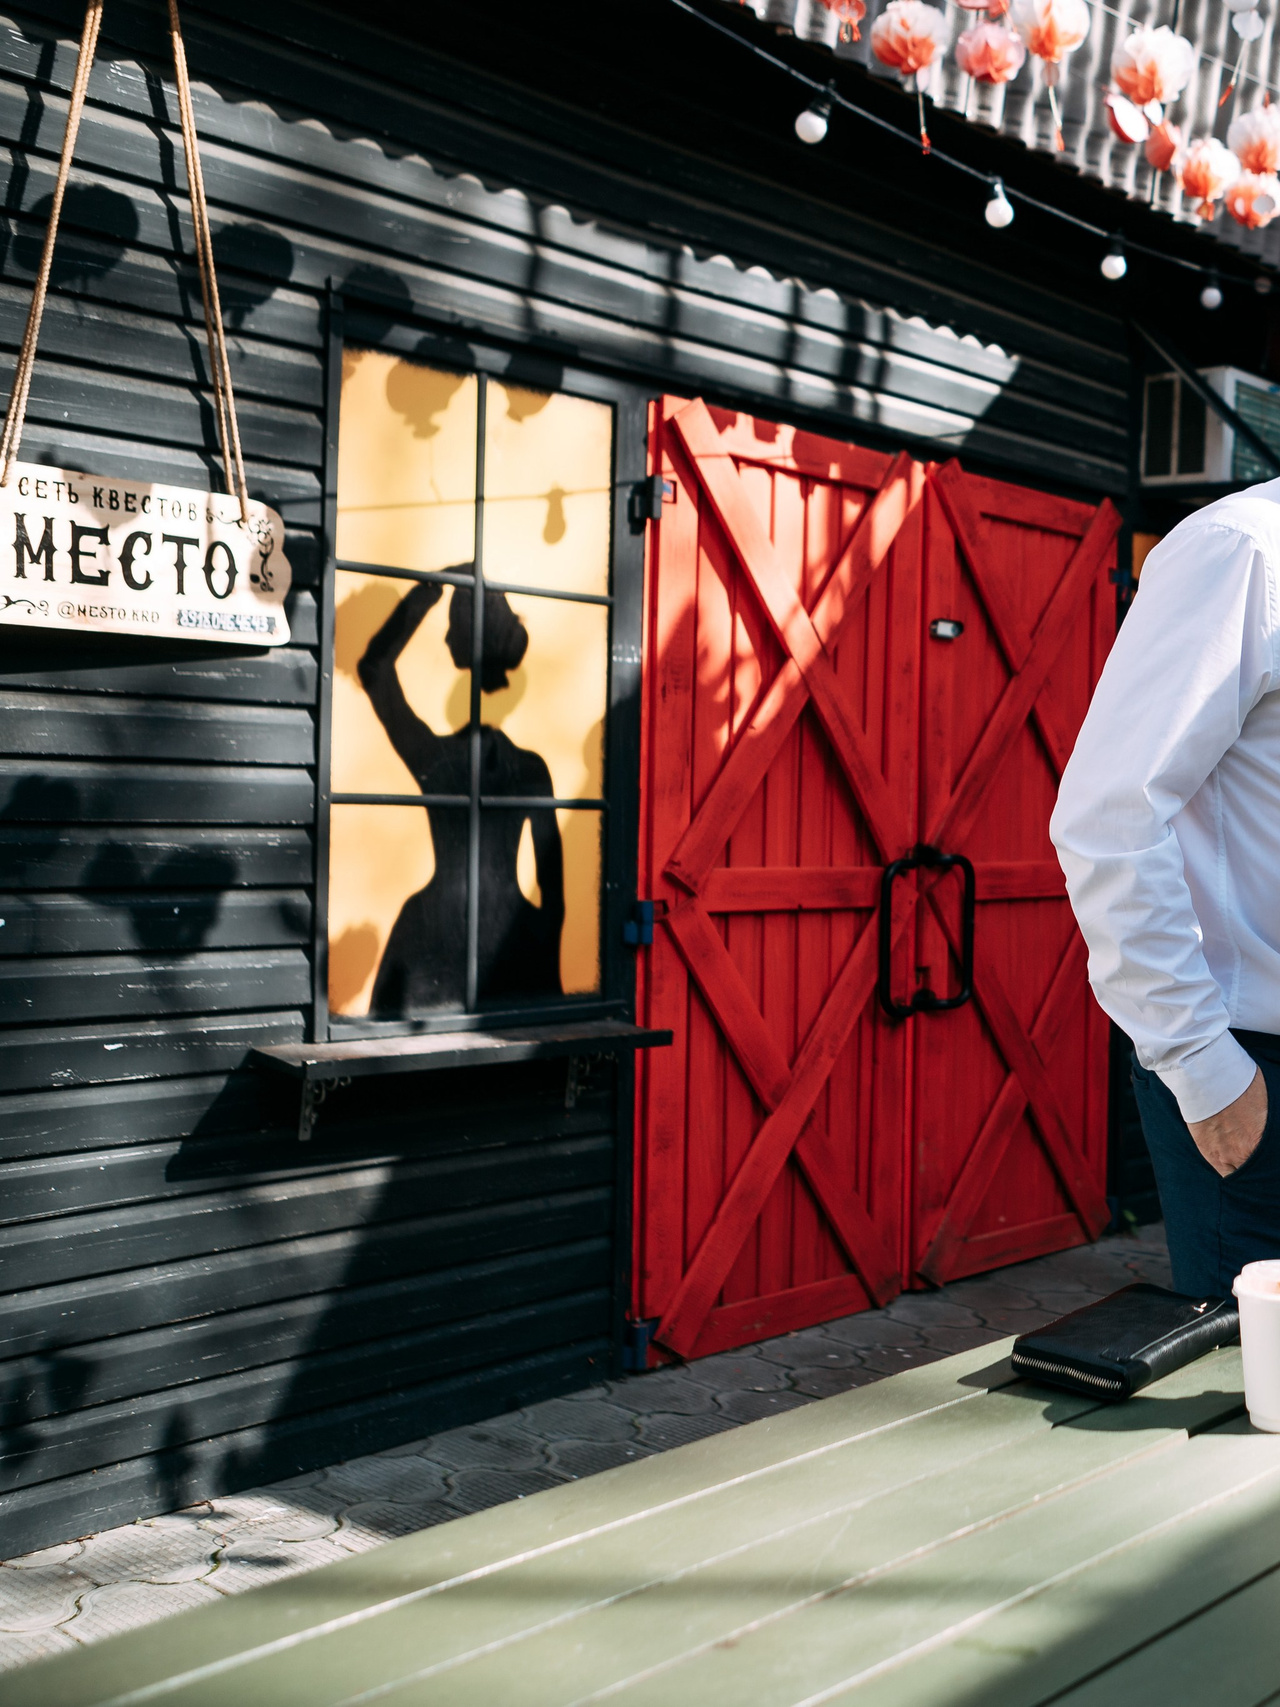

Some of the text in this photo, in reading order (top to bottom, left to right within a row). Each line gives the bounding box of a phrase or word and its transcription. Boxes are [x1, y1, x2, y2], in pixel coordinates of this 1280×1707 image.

[18, 476, 198, 522] СЕТЬ КВЕСТОВ
[12, 512, 239, 600] МЕСТО
